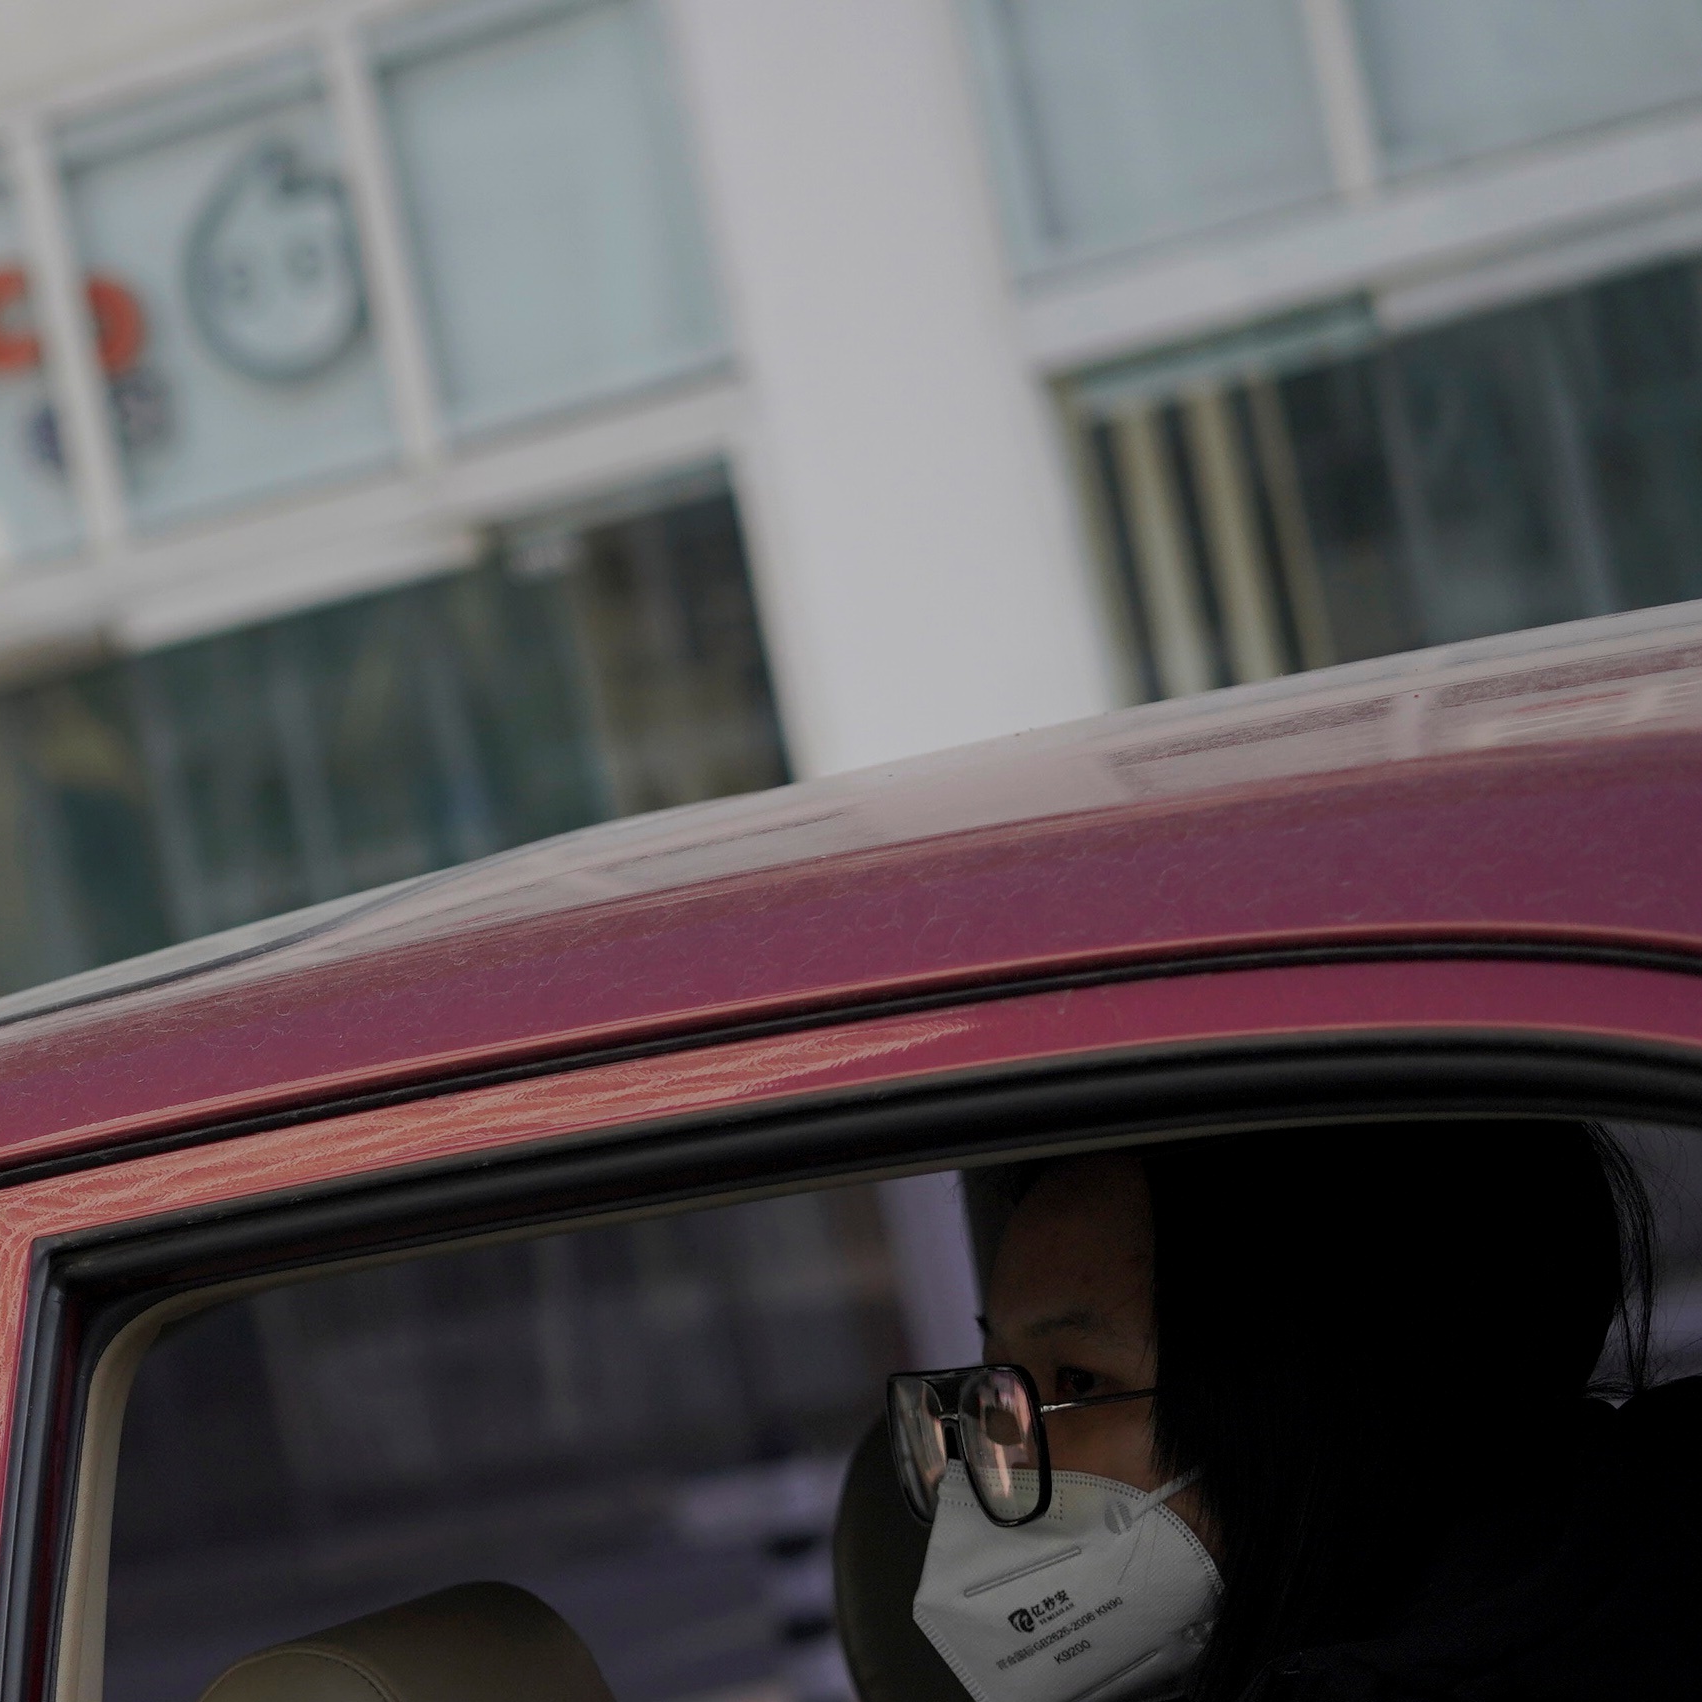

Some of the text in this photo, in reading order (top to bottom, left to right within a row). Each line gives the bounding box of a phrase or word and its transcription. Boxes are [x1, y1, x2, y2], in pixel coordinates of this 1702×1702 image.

[1031, 1589, 1070, 1618] 亿秒安
[1095, 1596, 1124, 1617] KN90
[1053, 1639, 1092, 1665] K9200
